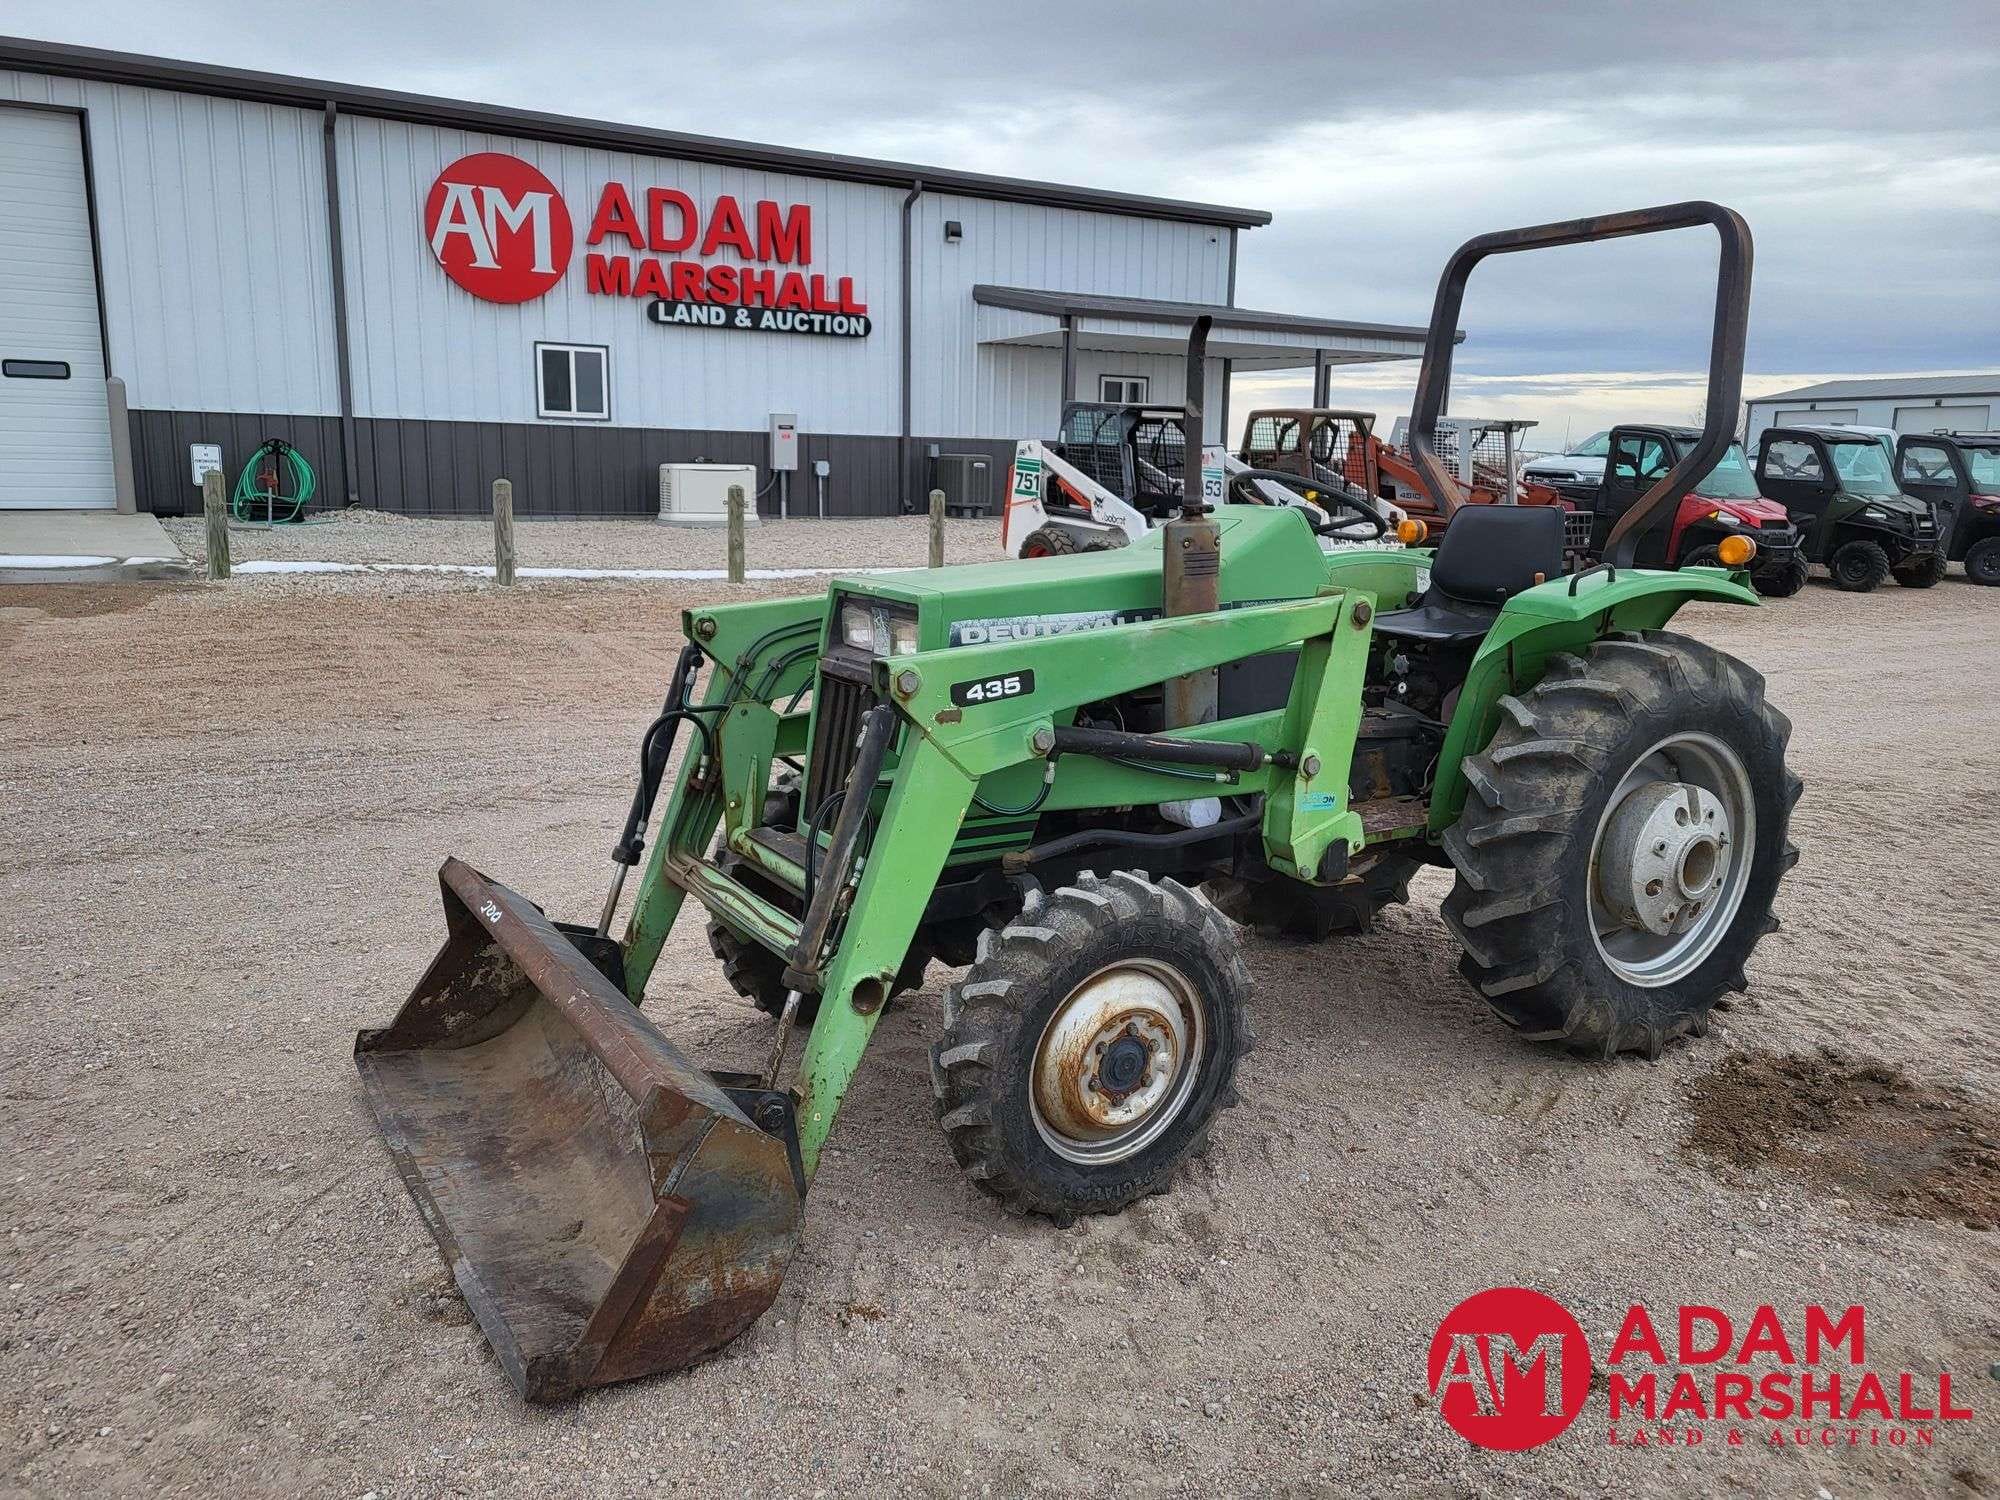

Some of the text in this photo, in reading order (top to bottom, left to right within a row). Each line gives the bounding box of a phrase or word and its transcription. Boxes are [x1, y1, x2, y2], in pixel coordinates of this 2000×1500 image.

[431, 181, 557, 275] AM
[586, 182, 811, 265] ADAM
[586, 254, 867, 314] MARSHALL
[657, 302, 866, 336] LAND & AUCTION
[1015, 471, 1040, 491] 751
[966, 676, 1021, 700] 435
